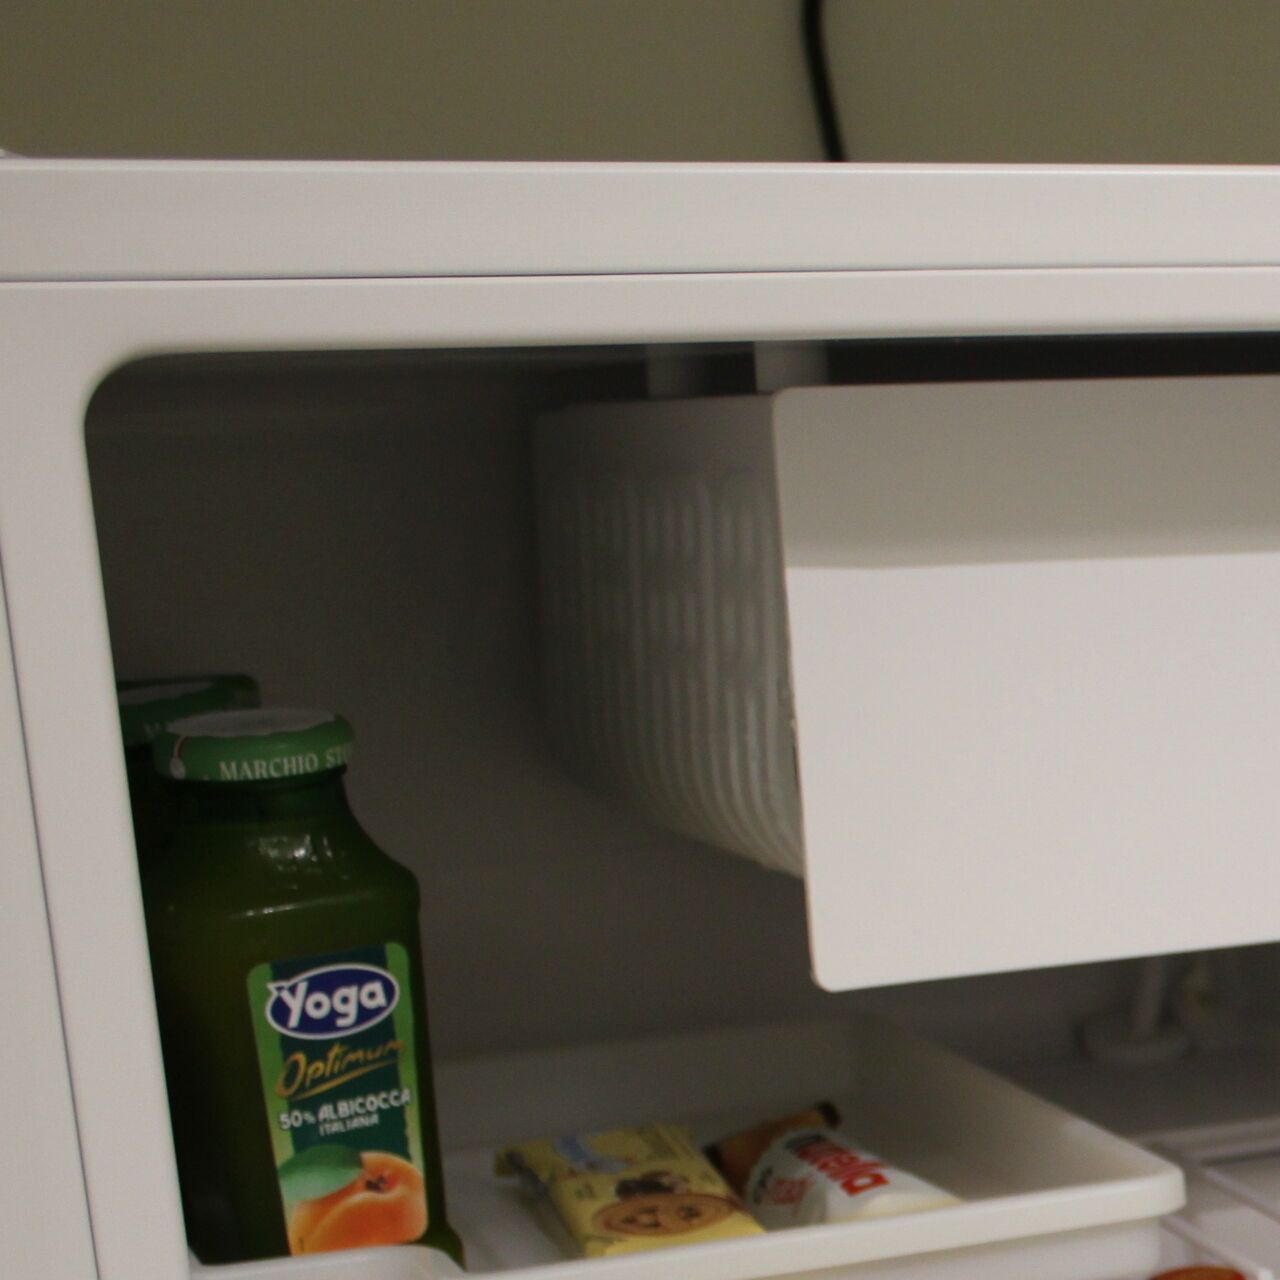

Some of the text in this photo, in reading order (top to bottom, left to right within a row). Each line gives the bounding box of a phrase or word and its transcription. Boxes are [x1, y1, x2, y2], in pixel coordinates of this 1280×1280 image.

[219, 752, 318, 781] MARCHIO
[280, 979, 388, 1029] Yoga
[279, 1088, 412, 1131] 50% ALBICOCCA
[319, 1113, 379, 1137] ITALIANA
